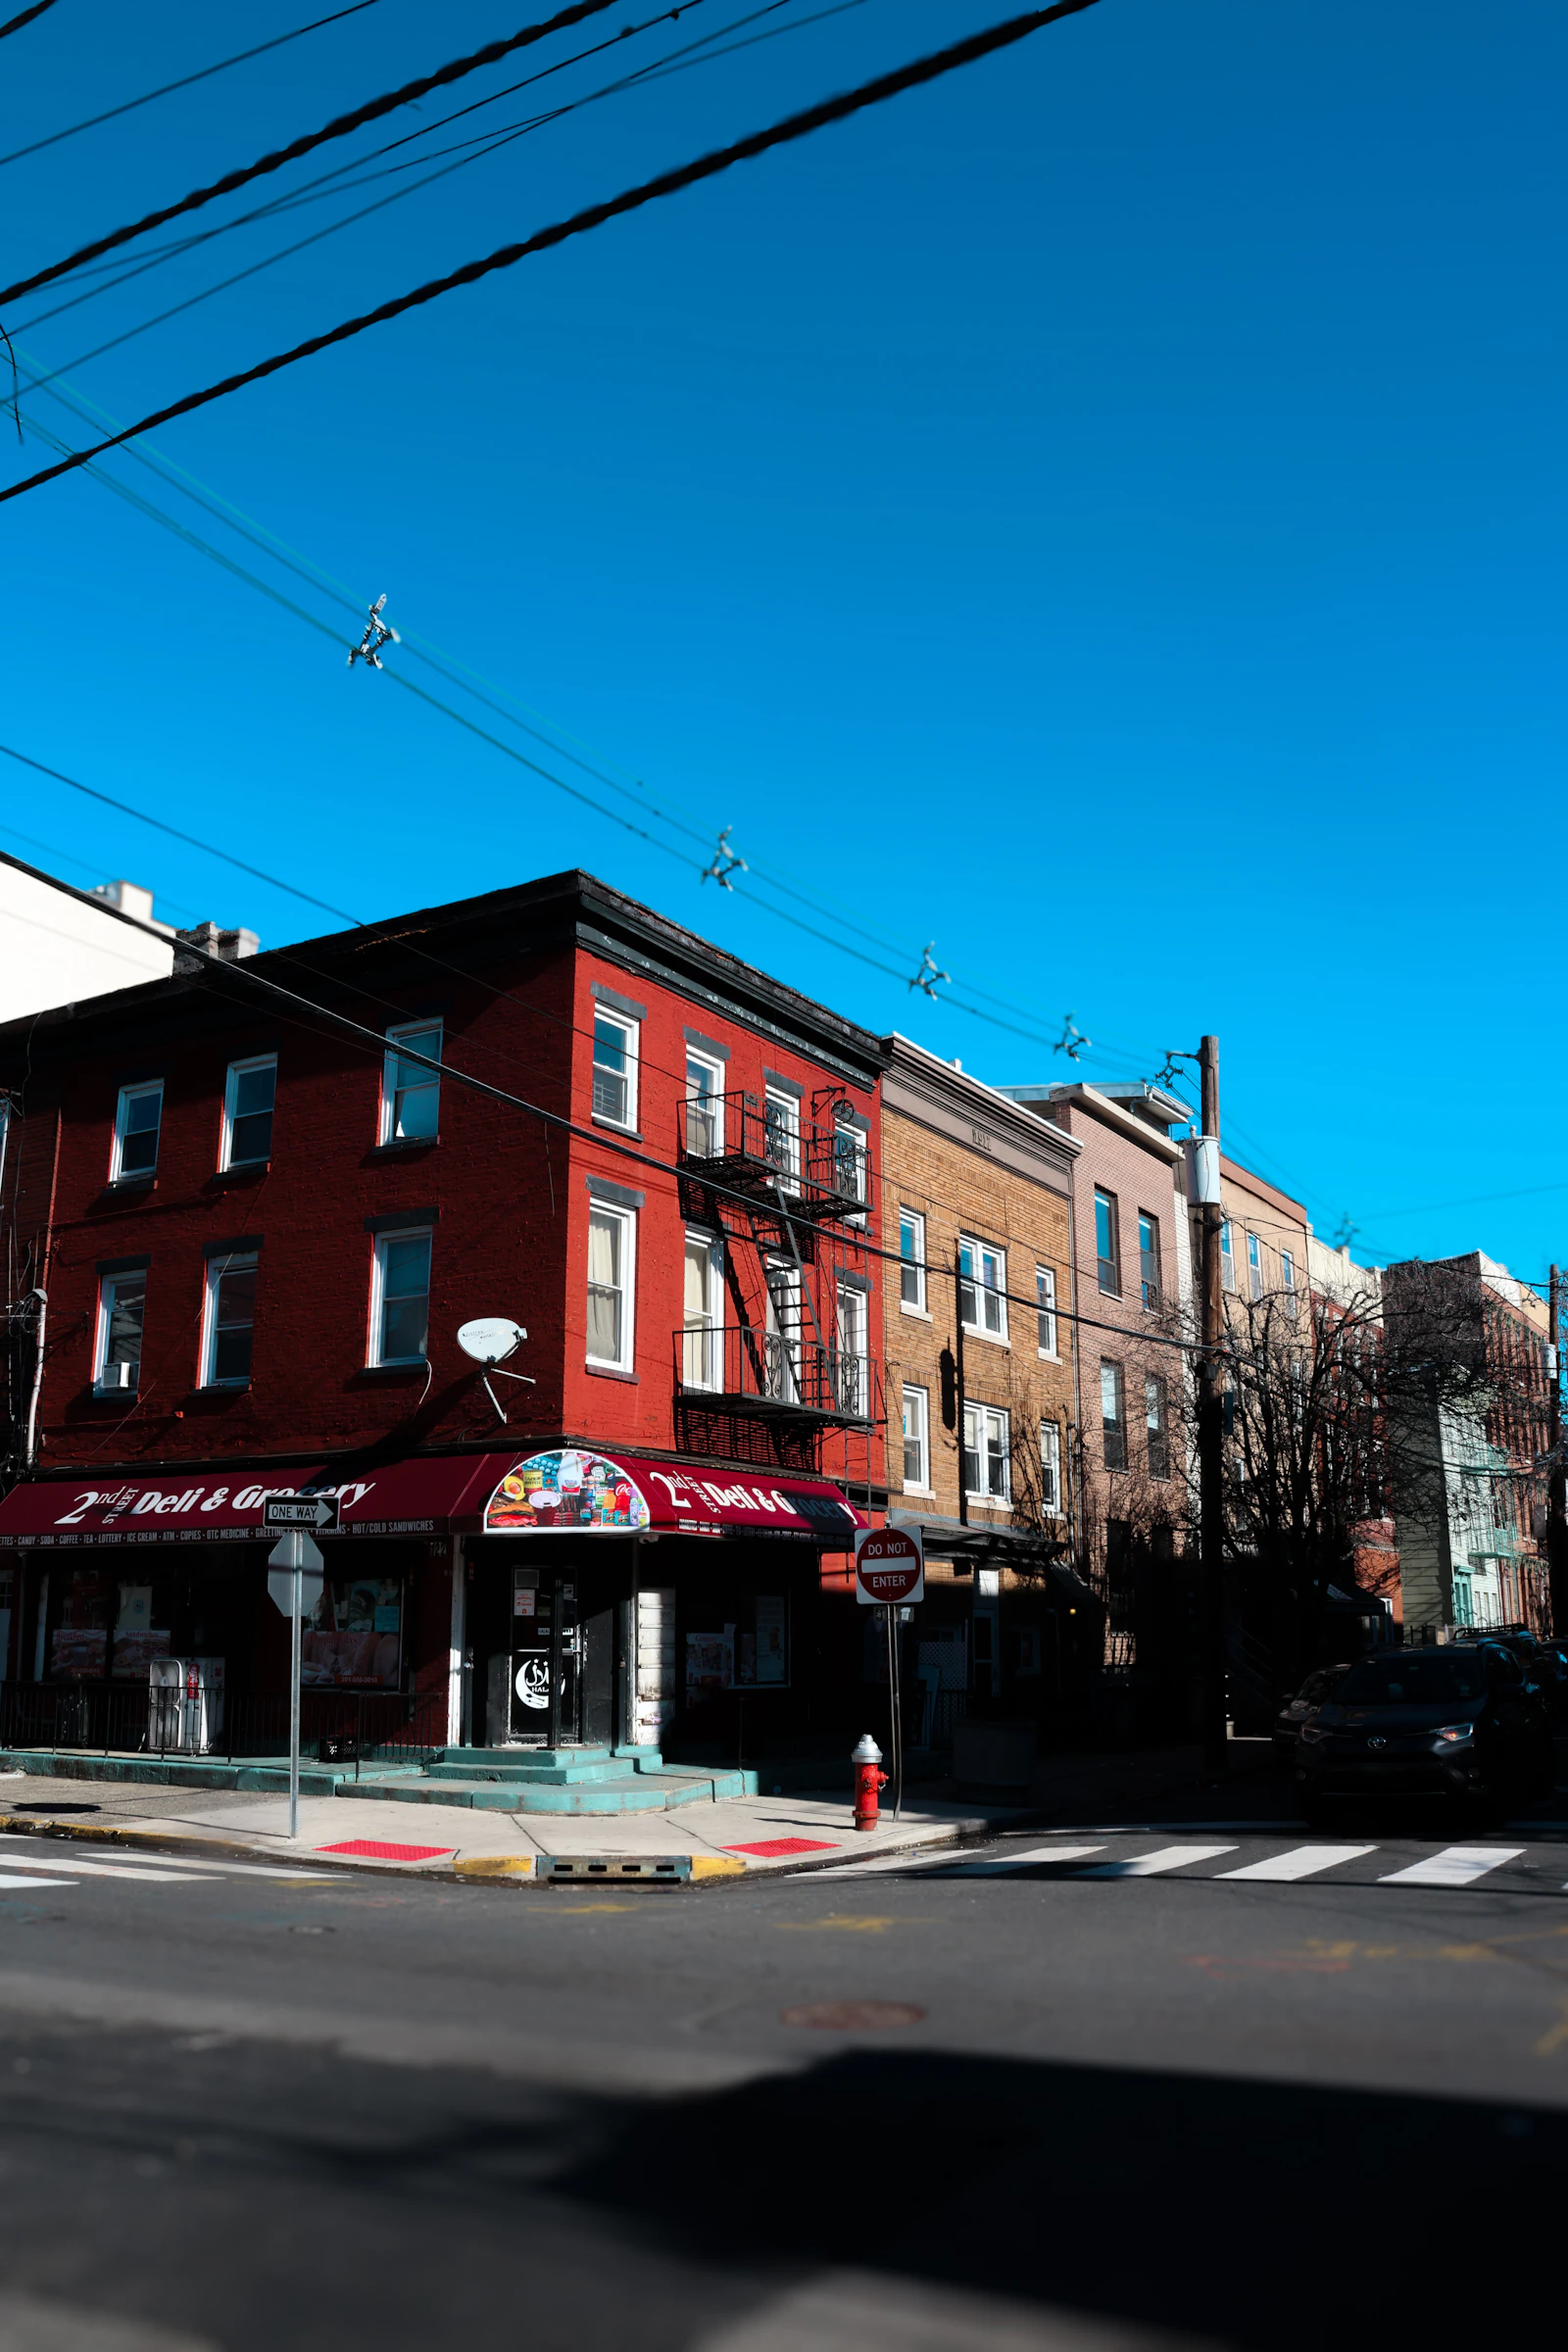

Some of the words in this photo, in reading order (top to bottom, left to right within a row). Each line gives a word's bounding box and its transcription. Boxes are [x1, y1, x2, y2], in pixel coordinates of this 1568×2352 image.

[650, 1470, 692, 1508] 2nd
[681, 1473, 721, 1513] STREET
[54, 1485, 126, 1525] 2nd
[101, 1488, 139, 1525] STREET
[128, 1487, 206, 1515] Deli
[200, 1487, 229, 1512] &
[700, 1482, 760, 1511] Deli
[752, 1487, 777, 1512] &
[770, 1490, 858, 1525] Grocery
[271, 1506, 292, 1518] ONE
[296, 1506, 318, 1519] WAY
[352, 1522, 387, 1535] HOT/COLD
[388, 1519, 434, 1533] SANDWICHES
[18, 1535, 36, 1545] CANDY
[40, 1535, 55, 1545] SODA
[59, 1534, 78, 1544] COFFEE
[83, 1534, 94, 1544] TEA
[98, 1533, 122, 1544] LOTTERY
[126, 1532, 136, 1543] ICE
[137, 1531, 157, 1543] CREAM
[162, 1531, 174, 1542] ATM
[180, 1530, 202, 1541] COPIES
[207, 1529, 219, 1540] OTC
[220, 1528, 250, 1539] MEDICINE
[867, 1544, 882, 1556] DO
[887, 1542, 907, 1554] NOT
[872, 1575, 906, 1588] ENTER
